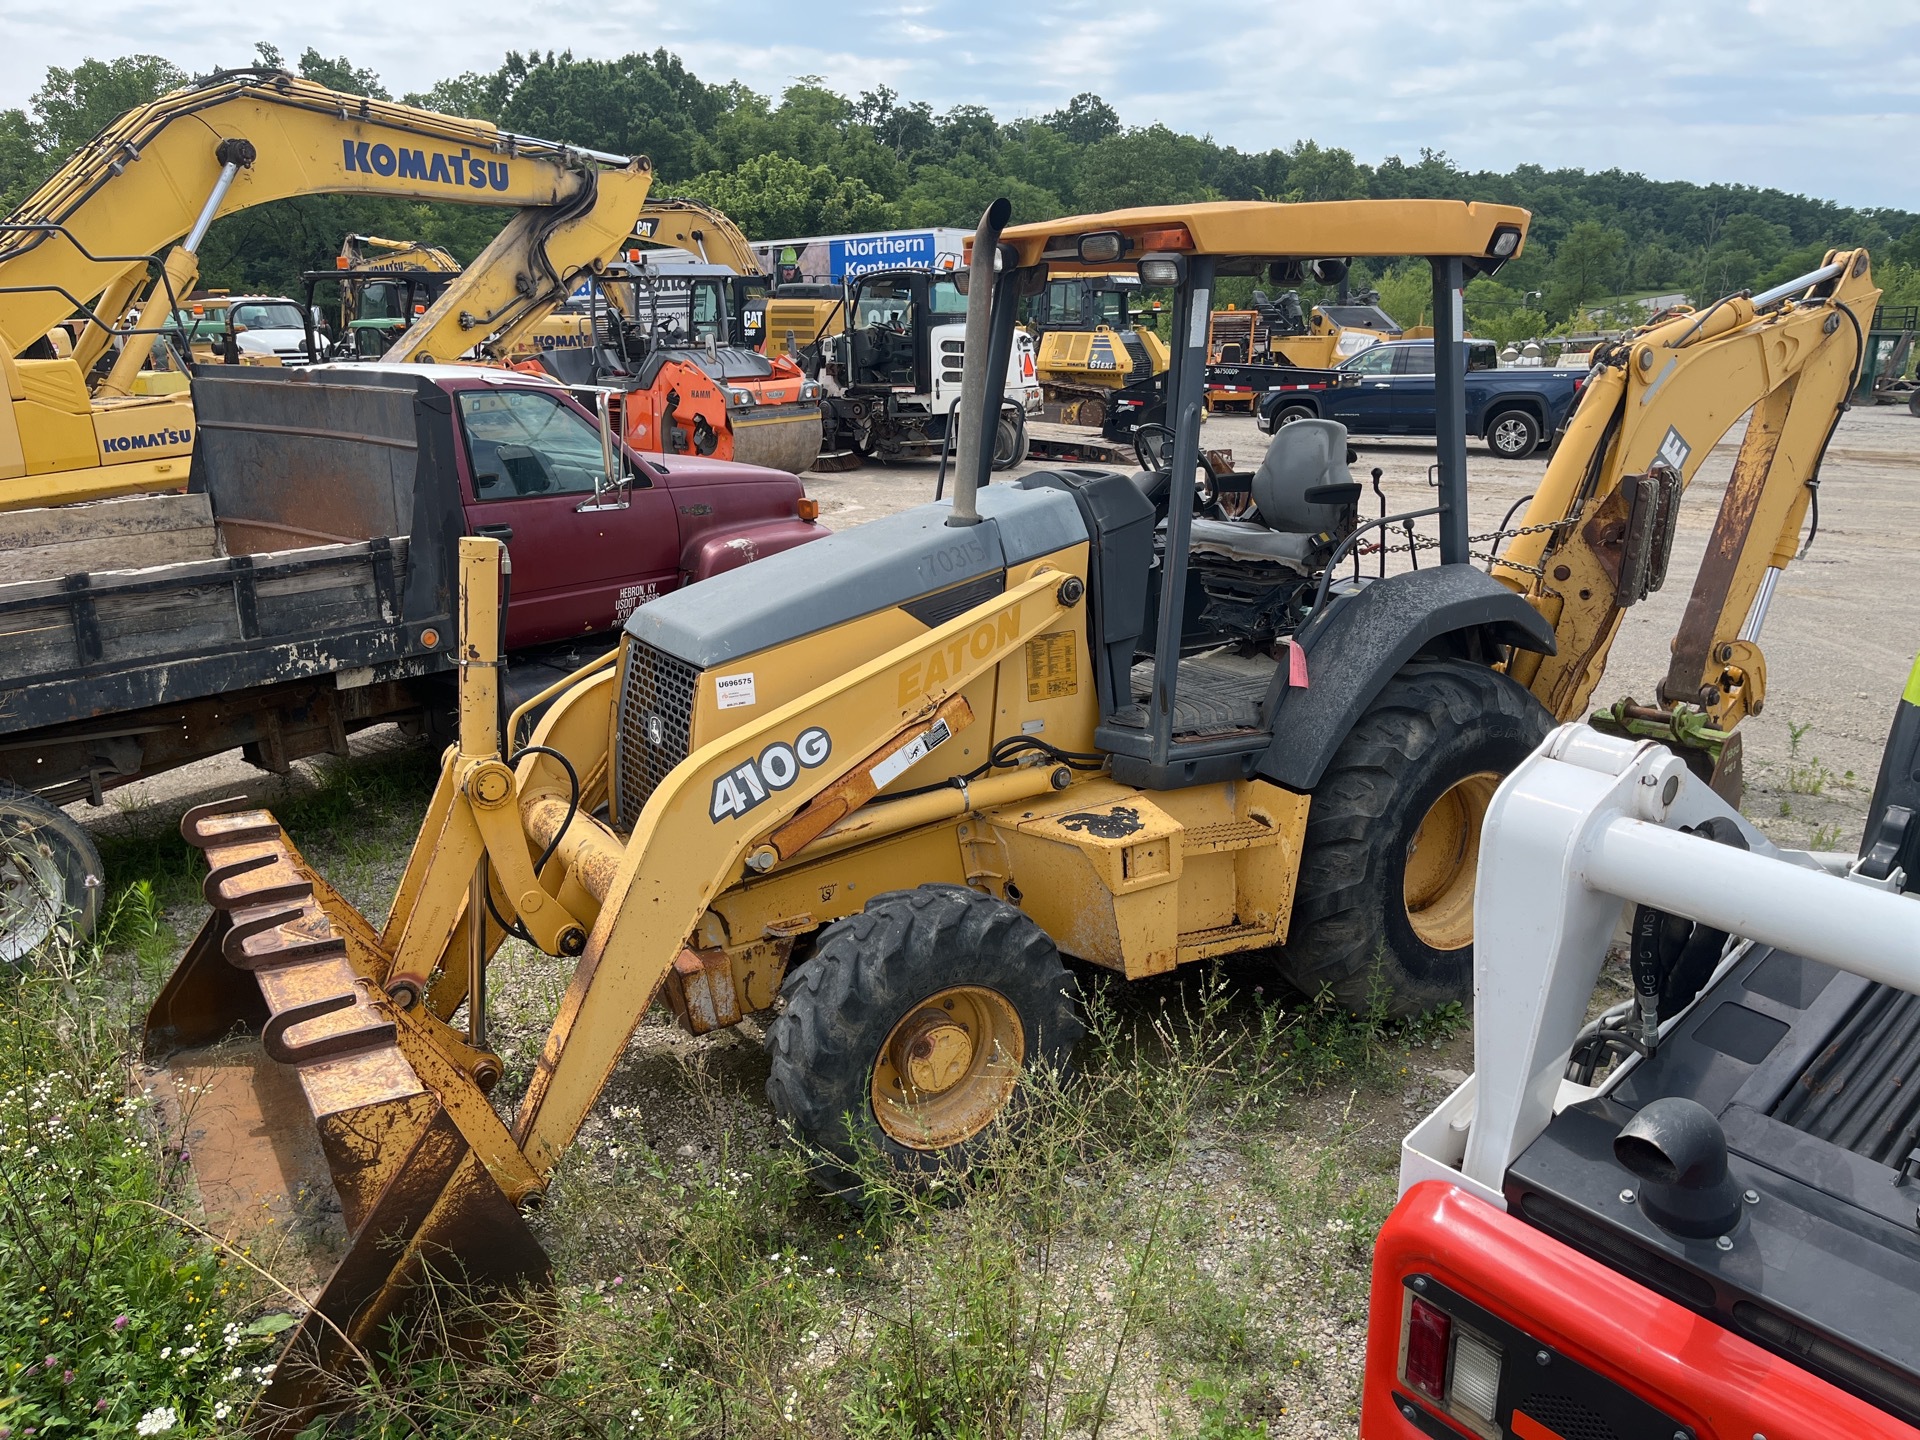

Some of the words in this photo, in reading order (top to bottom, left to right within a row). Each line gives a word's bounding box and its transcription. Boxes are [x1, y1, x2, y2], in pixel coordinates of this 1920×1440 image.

[343, 140, 509, 191] KOMATSU
[637, 221, 652, 237] CAT
[844, 237, 925, 257] Northern
[845, 257, 930, 276] Kentucky
[744, 311, 763, 328] CAT
[532, 335, 592, 347] KOMATS
[691, 390, 711, 399] HAMM
[103, 428, 192, 453] KOMATSU
[620, 585, 646, 599] HEBRON,
[647, 583, 657, 594] KY
[615, 597, 637, 611] USDOT
[617, 608, 632, 620] KYU
[898, 603, 1021, 708] EATON
[718, 677, 752, 688] U696575
[710, 727, 831, 823] 410G
